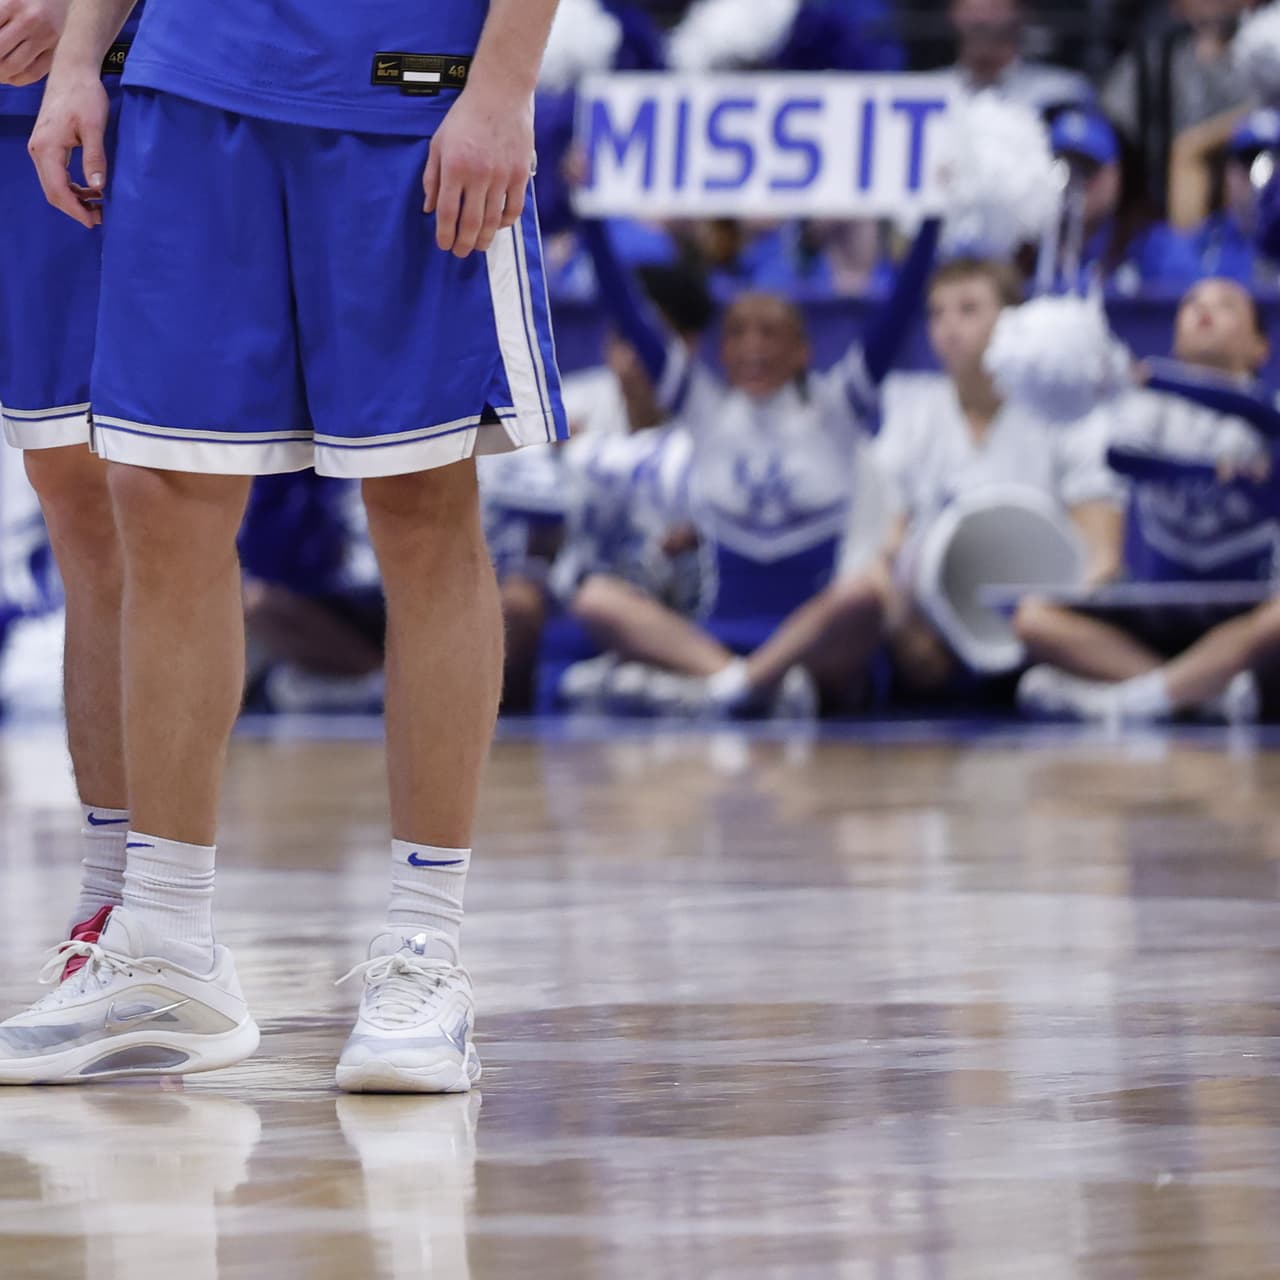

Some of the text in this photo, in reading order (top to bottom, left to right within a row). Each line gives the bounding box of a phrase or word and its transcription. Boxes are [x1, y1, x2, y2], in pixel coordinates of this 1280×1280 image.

[447, 64, 466, 79] 48
[585, 97, 948, 194] MISS IT
